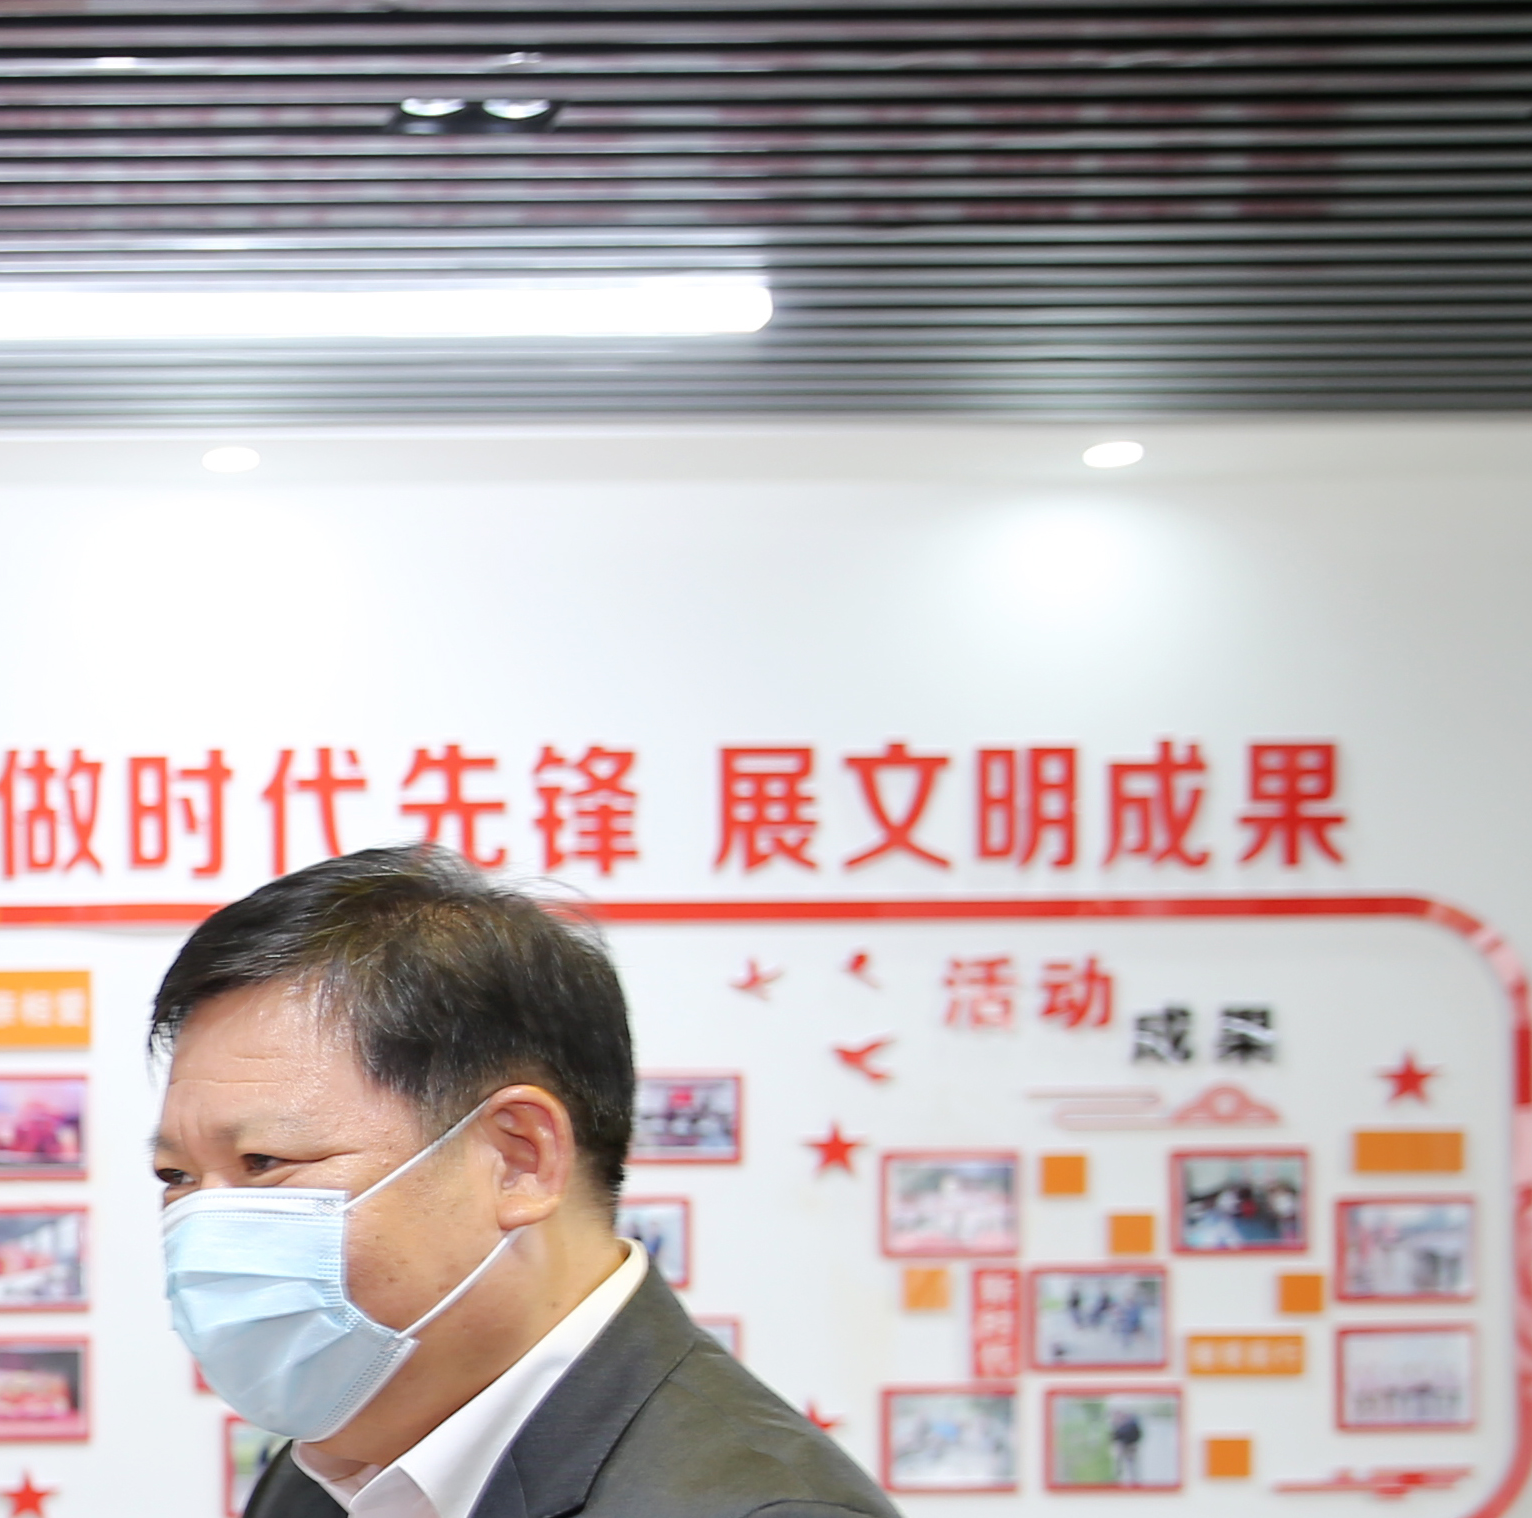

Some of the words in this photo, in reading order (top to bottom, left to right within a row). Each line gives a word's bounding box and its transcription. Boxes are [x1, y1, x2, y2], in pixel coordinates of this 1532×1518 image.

[713, 741, 1348, 872] 展文明成果
